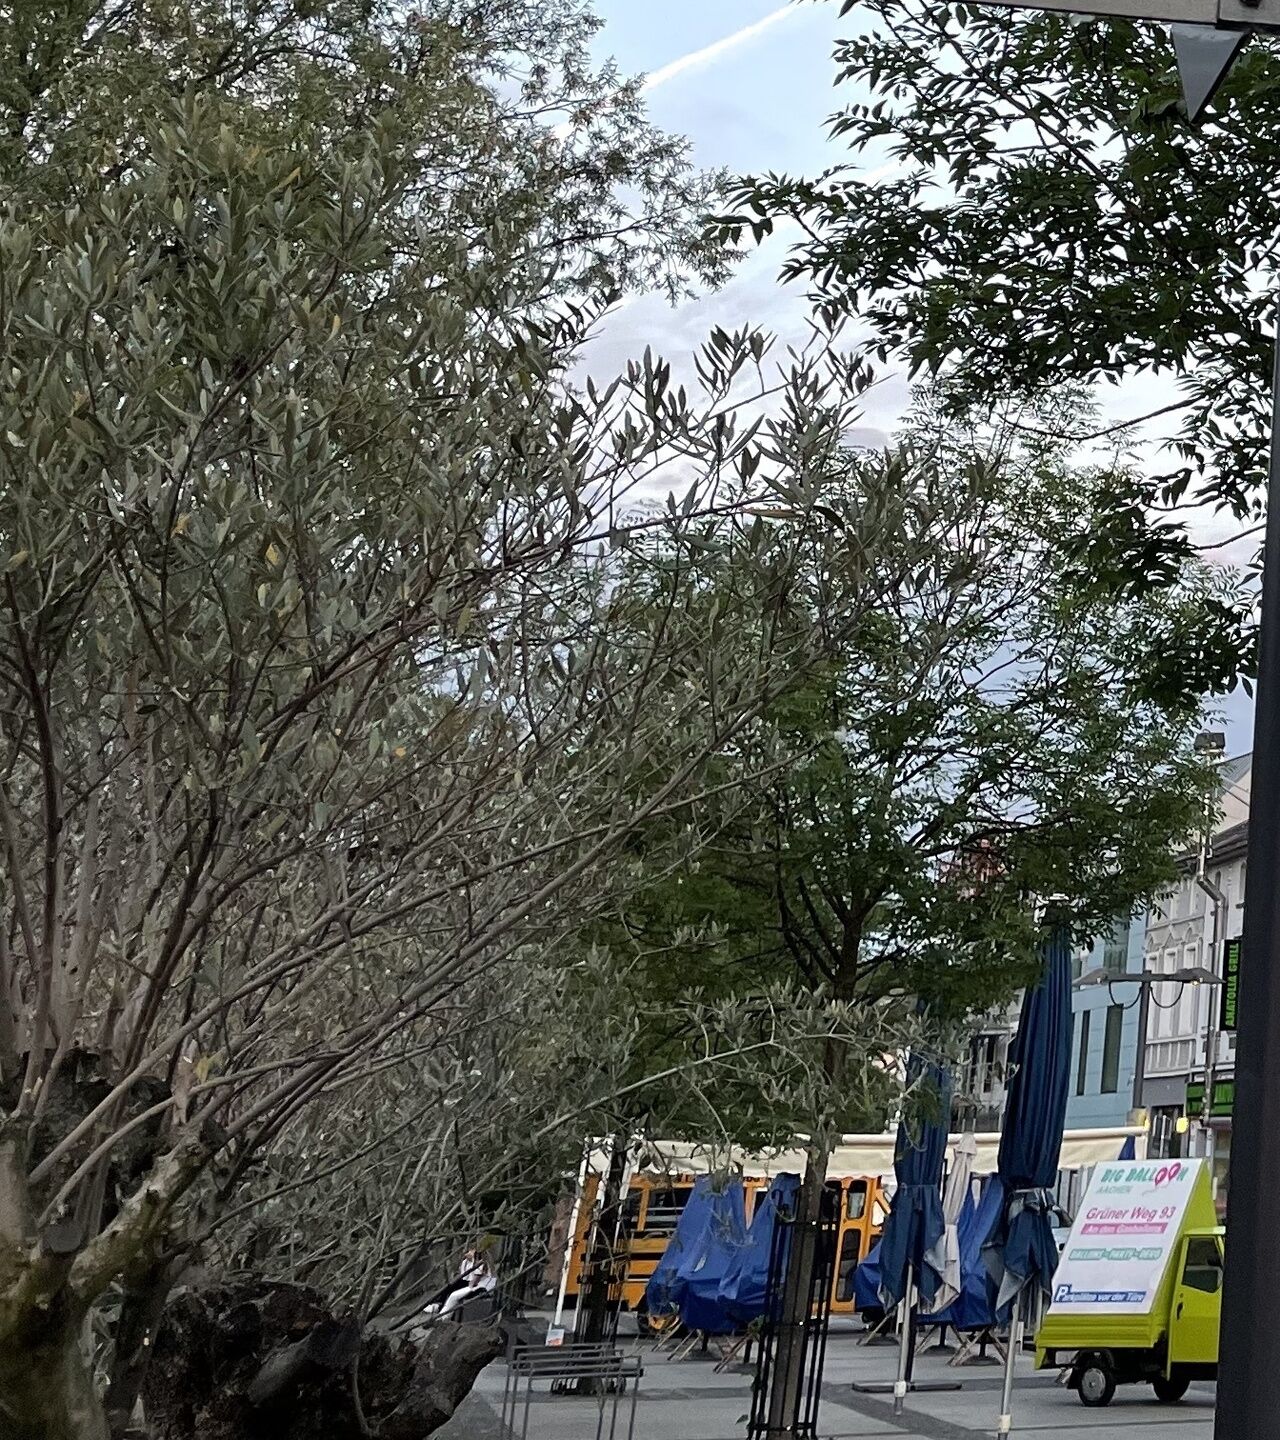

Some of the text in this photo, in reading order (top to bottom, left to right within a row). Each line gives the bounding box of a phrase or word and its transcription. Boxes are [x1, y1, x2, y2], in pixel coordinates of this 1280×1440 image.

[1101, 1168, 1124, 1183] BIG
[1086, 1206, 1177, 1222] Grüner Weg 93
